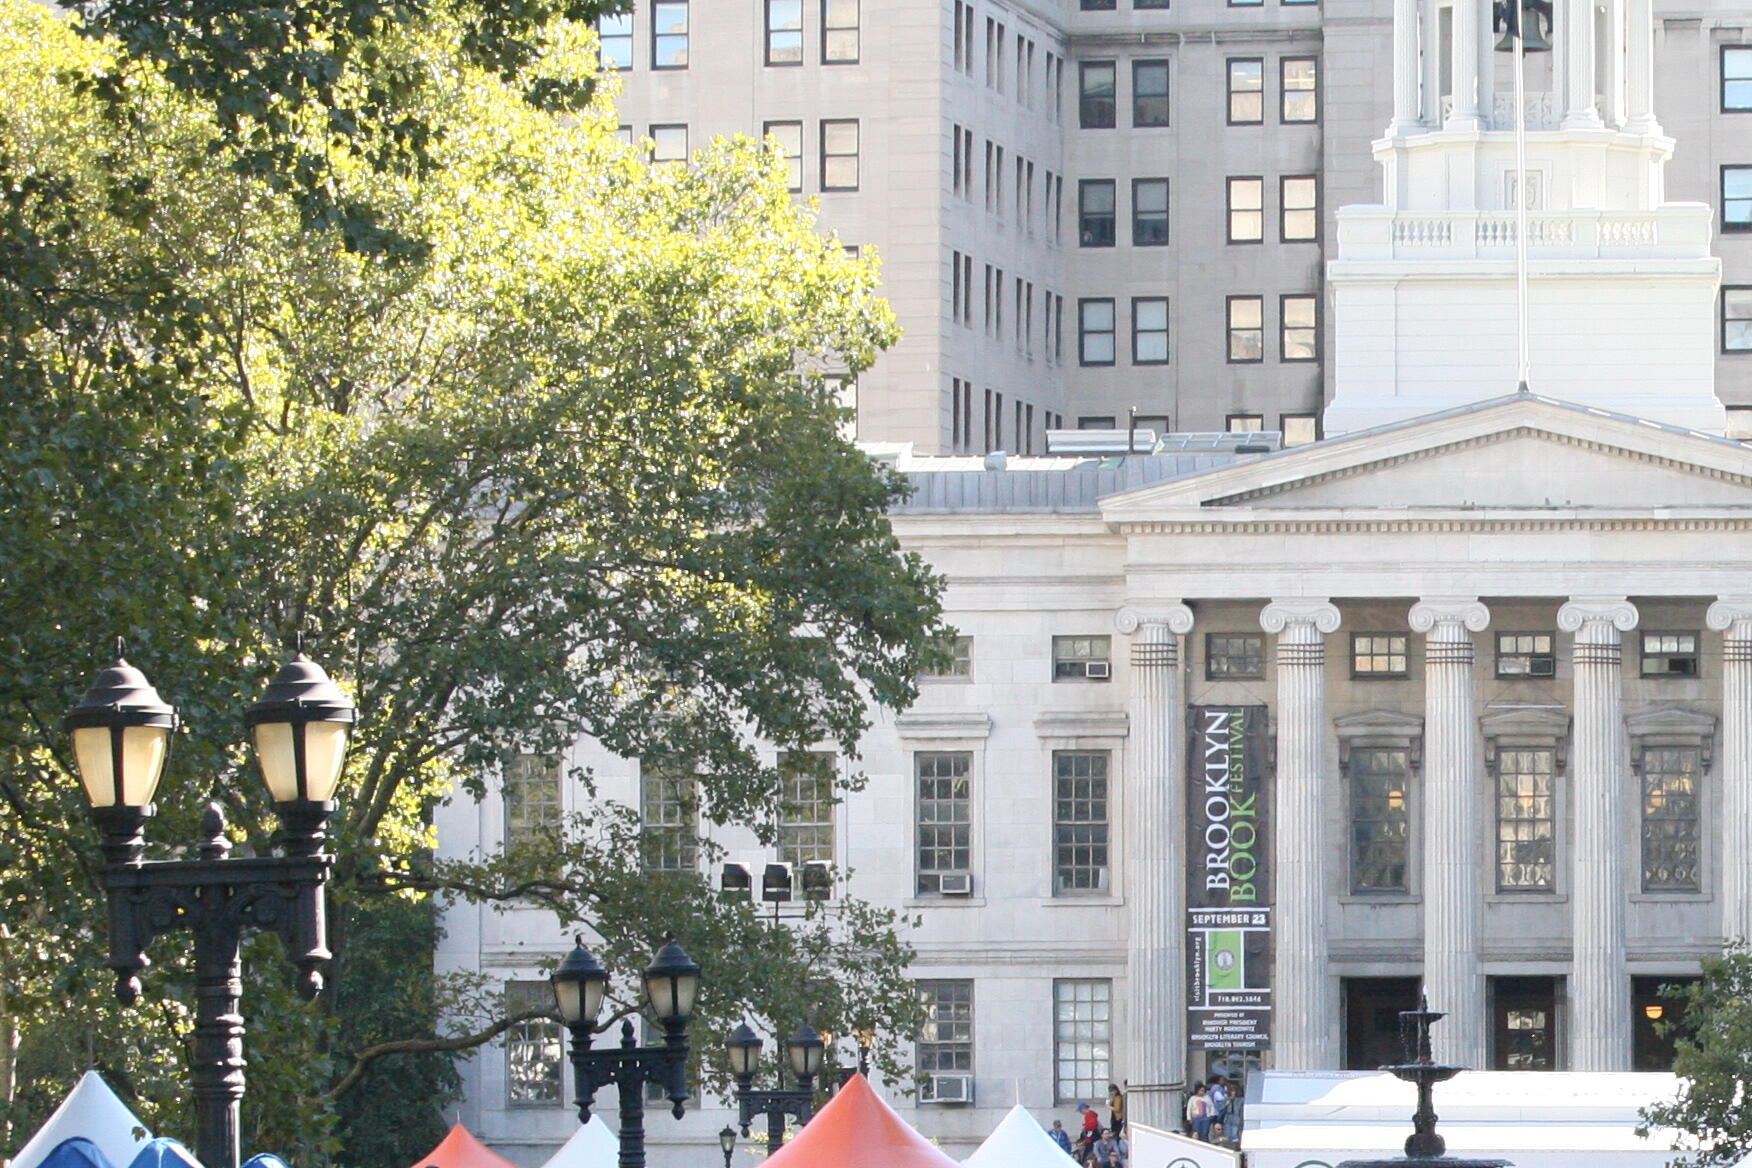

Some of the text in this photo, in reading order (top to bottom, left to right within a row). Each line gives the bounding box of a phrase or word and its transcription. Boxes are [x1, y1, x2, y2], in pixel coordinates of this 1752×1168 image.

[1205, 710, 1230, 891] BROOKLYN
[1230, 708, 1256, 902] BOOK FESTIVAL
[1192, 914, 1266, 925] SEPTEMBER 23
